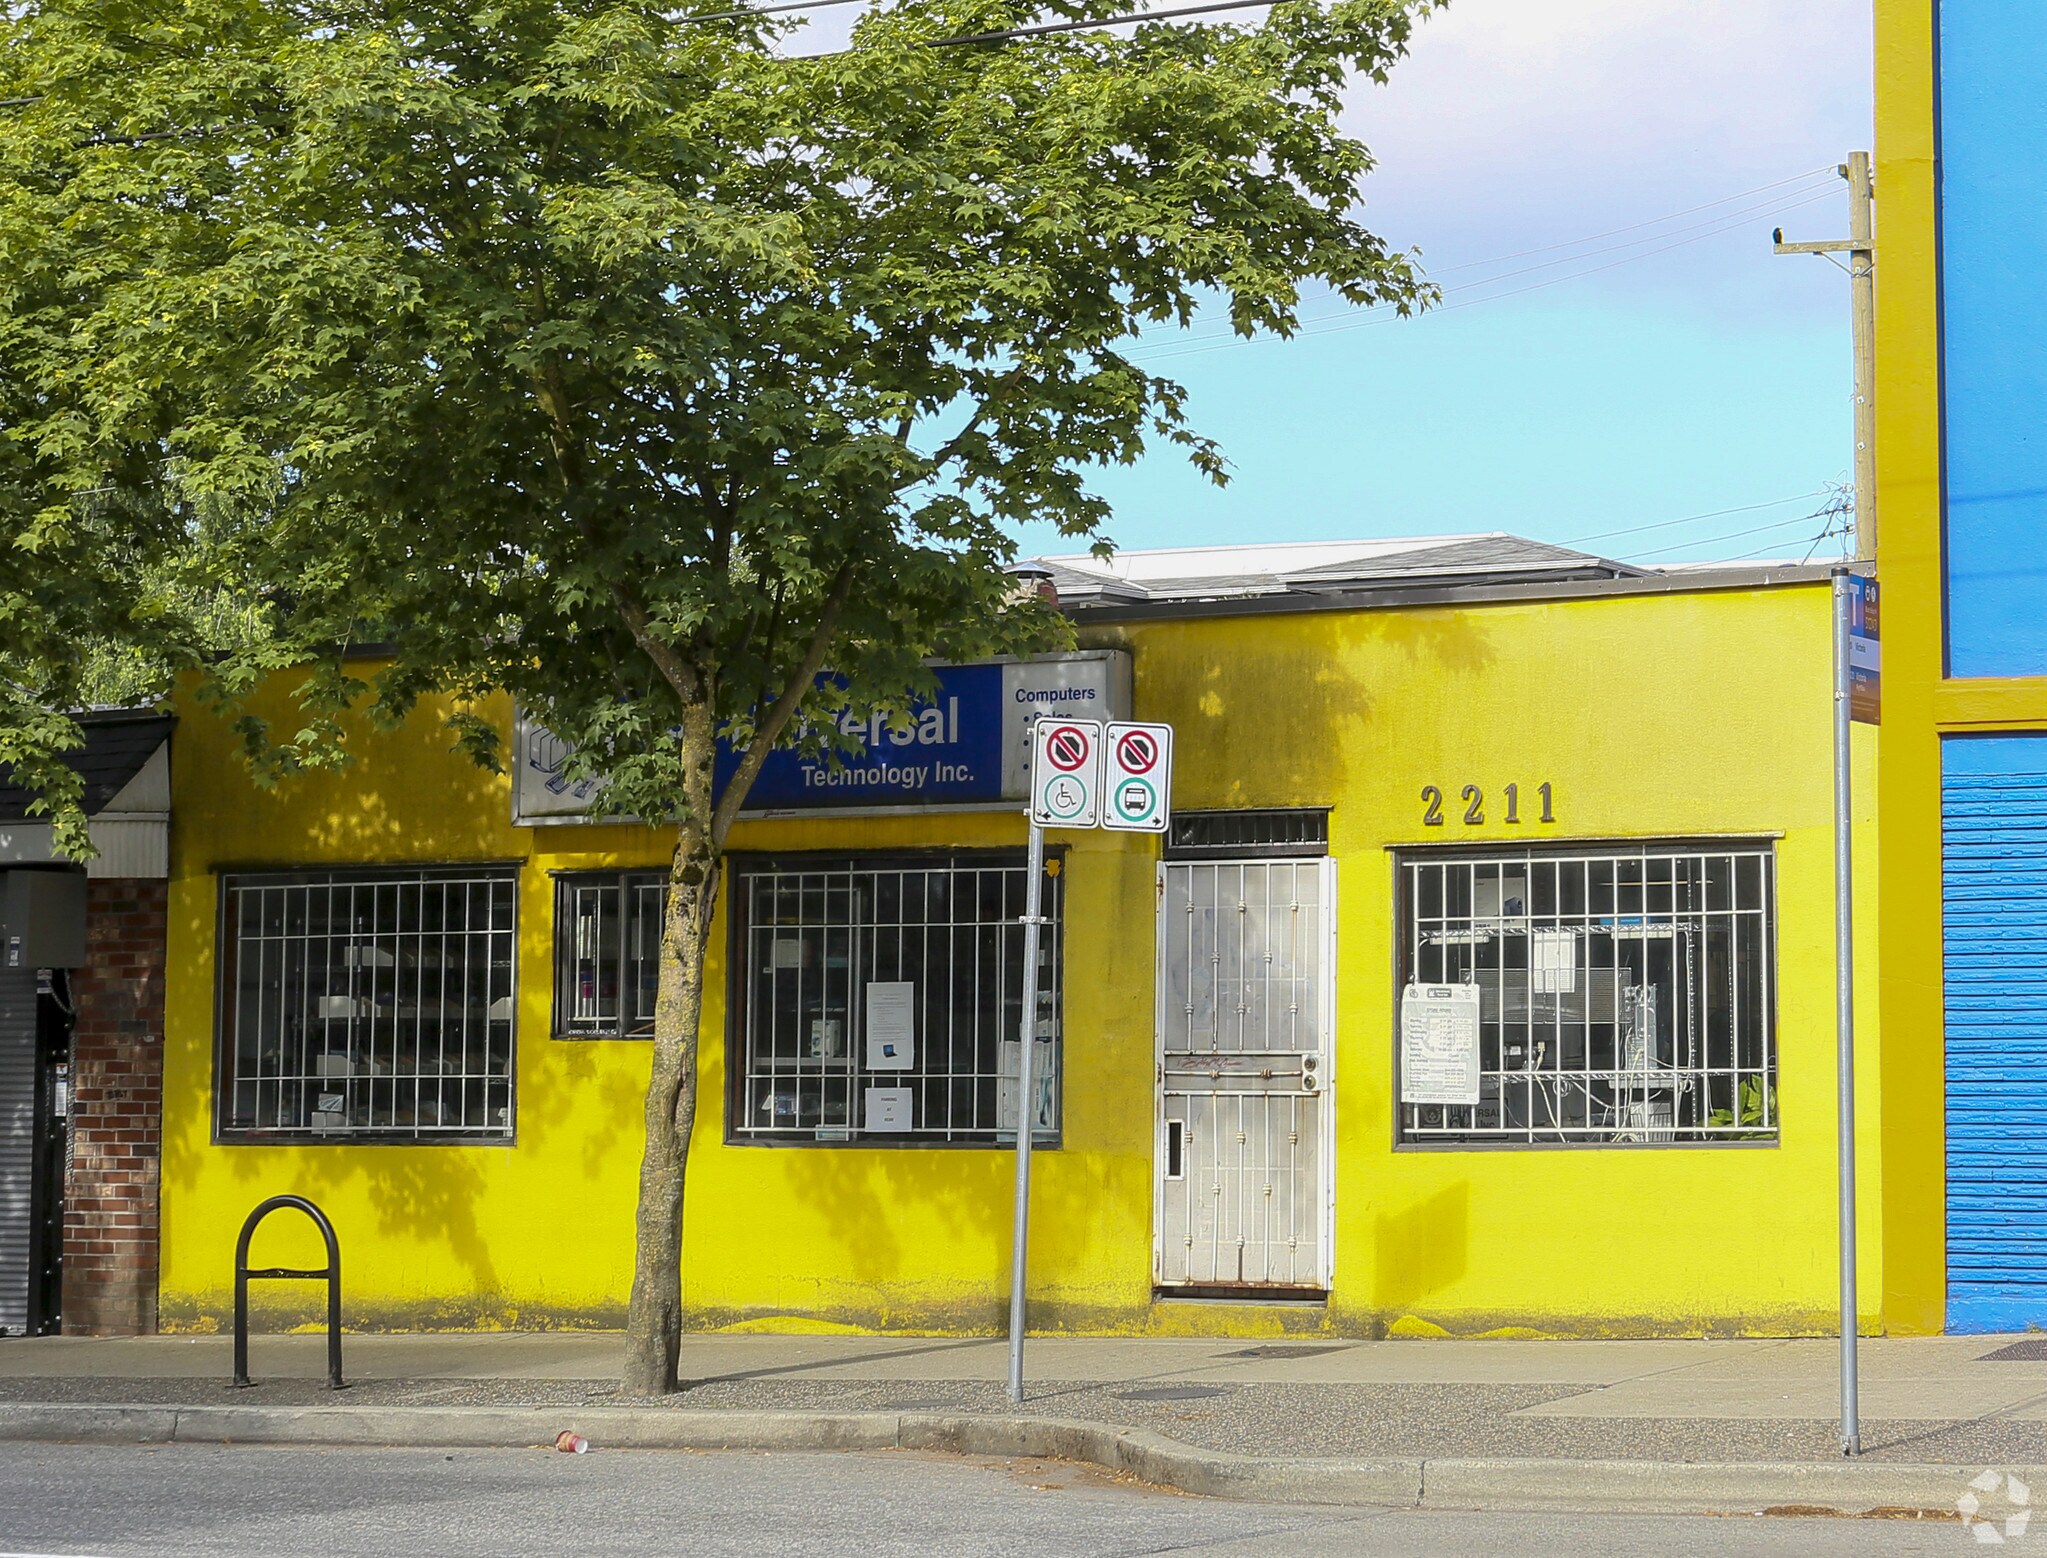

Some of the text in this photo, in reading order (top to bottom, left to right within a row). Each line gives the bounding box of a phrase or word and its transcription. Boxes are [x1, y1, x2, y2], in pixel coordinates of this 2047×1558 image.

[1015, 687, 1096, 705] Computers
[731, 696, 959, 753] iersal
[801, 761, 974, 790] Technology Inc.
[1420, 781, 1556, 826] 2211
